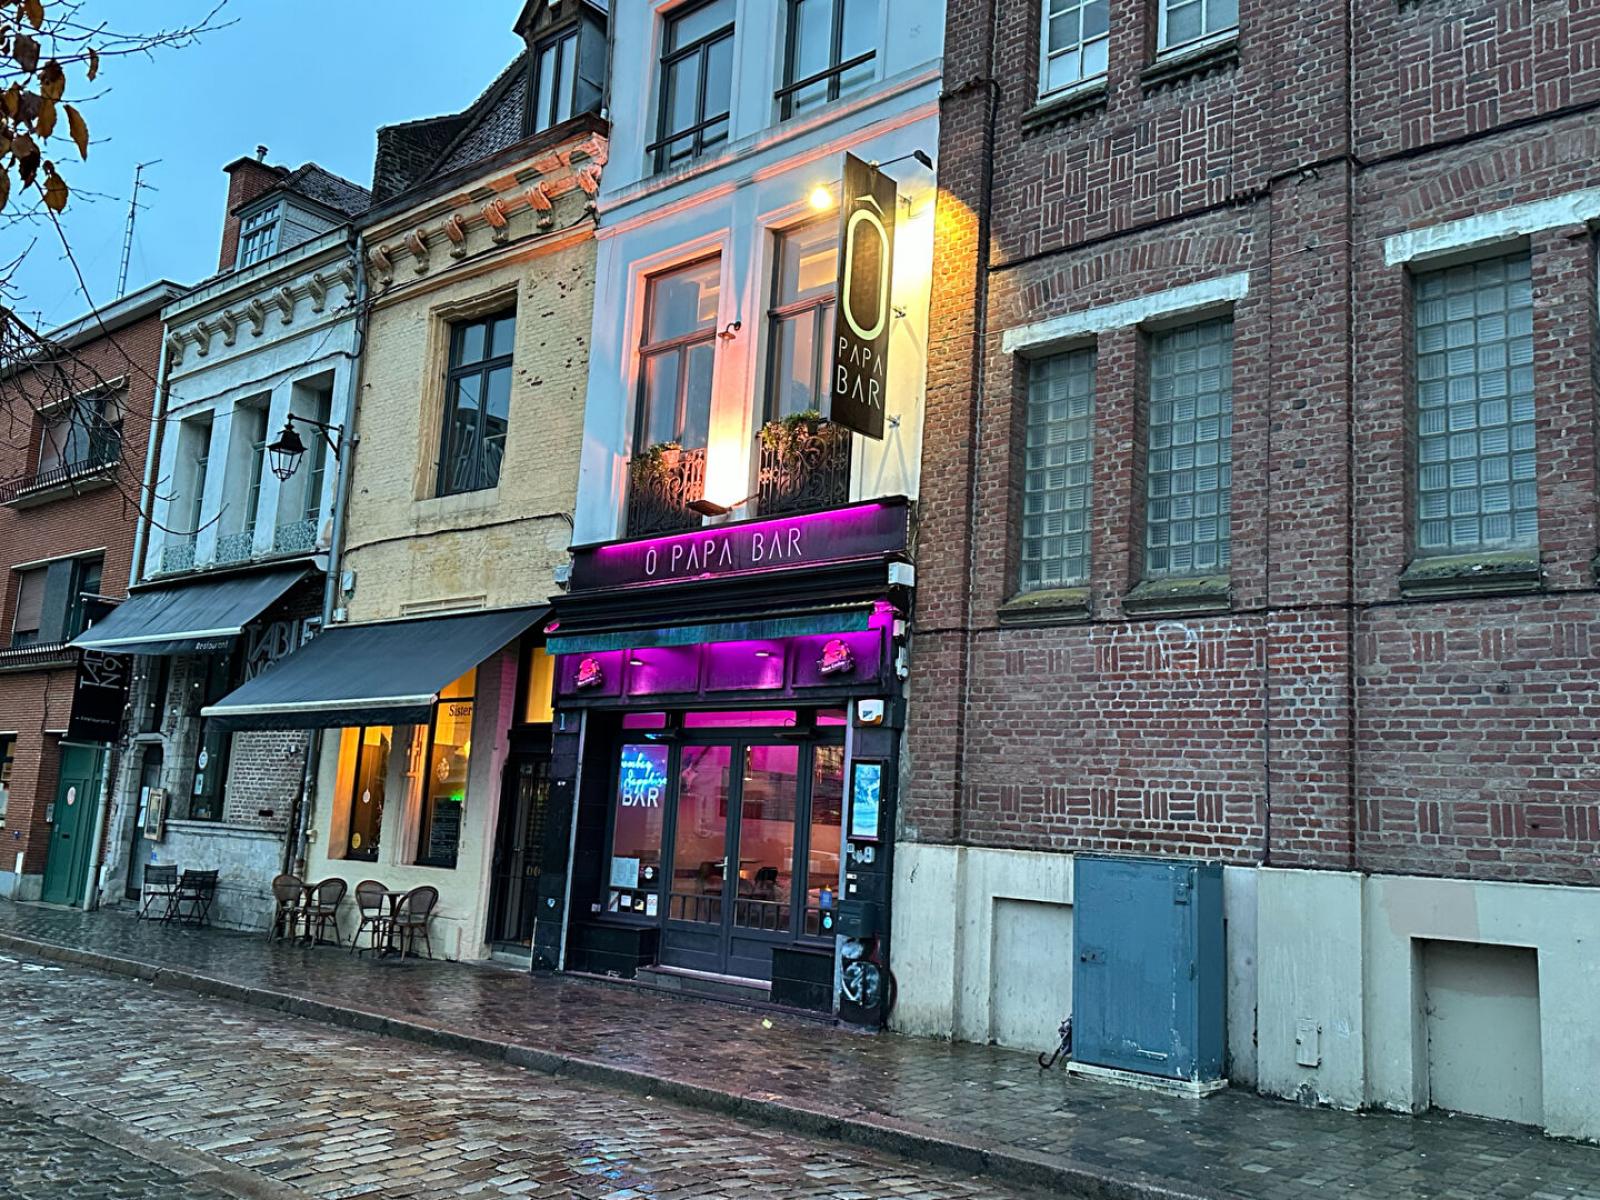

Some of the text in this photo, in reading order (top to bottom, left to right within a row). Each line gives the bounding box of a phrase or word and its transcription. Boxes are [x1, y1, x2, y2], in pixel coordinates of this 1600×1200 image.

[843, 194, 890, 341] Ô
[839, 336, 883, 377] PAPA
[836, 364, 881, 410] BAR
[645, 527, 803, 576] Ô PAPA BAR
[194, 640, 230, 651] Restaurant
[448, 704, 472, 717] Sister
[559, 712, 566, 731] 1
[620, 752, 654, 778] unky
[621, 786, 660, 808] BAR
